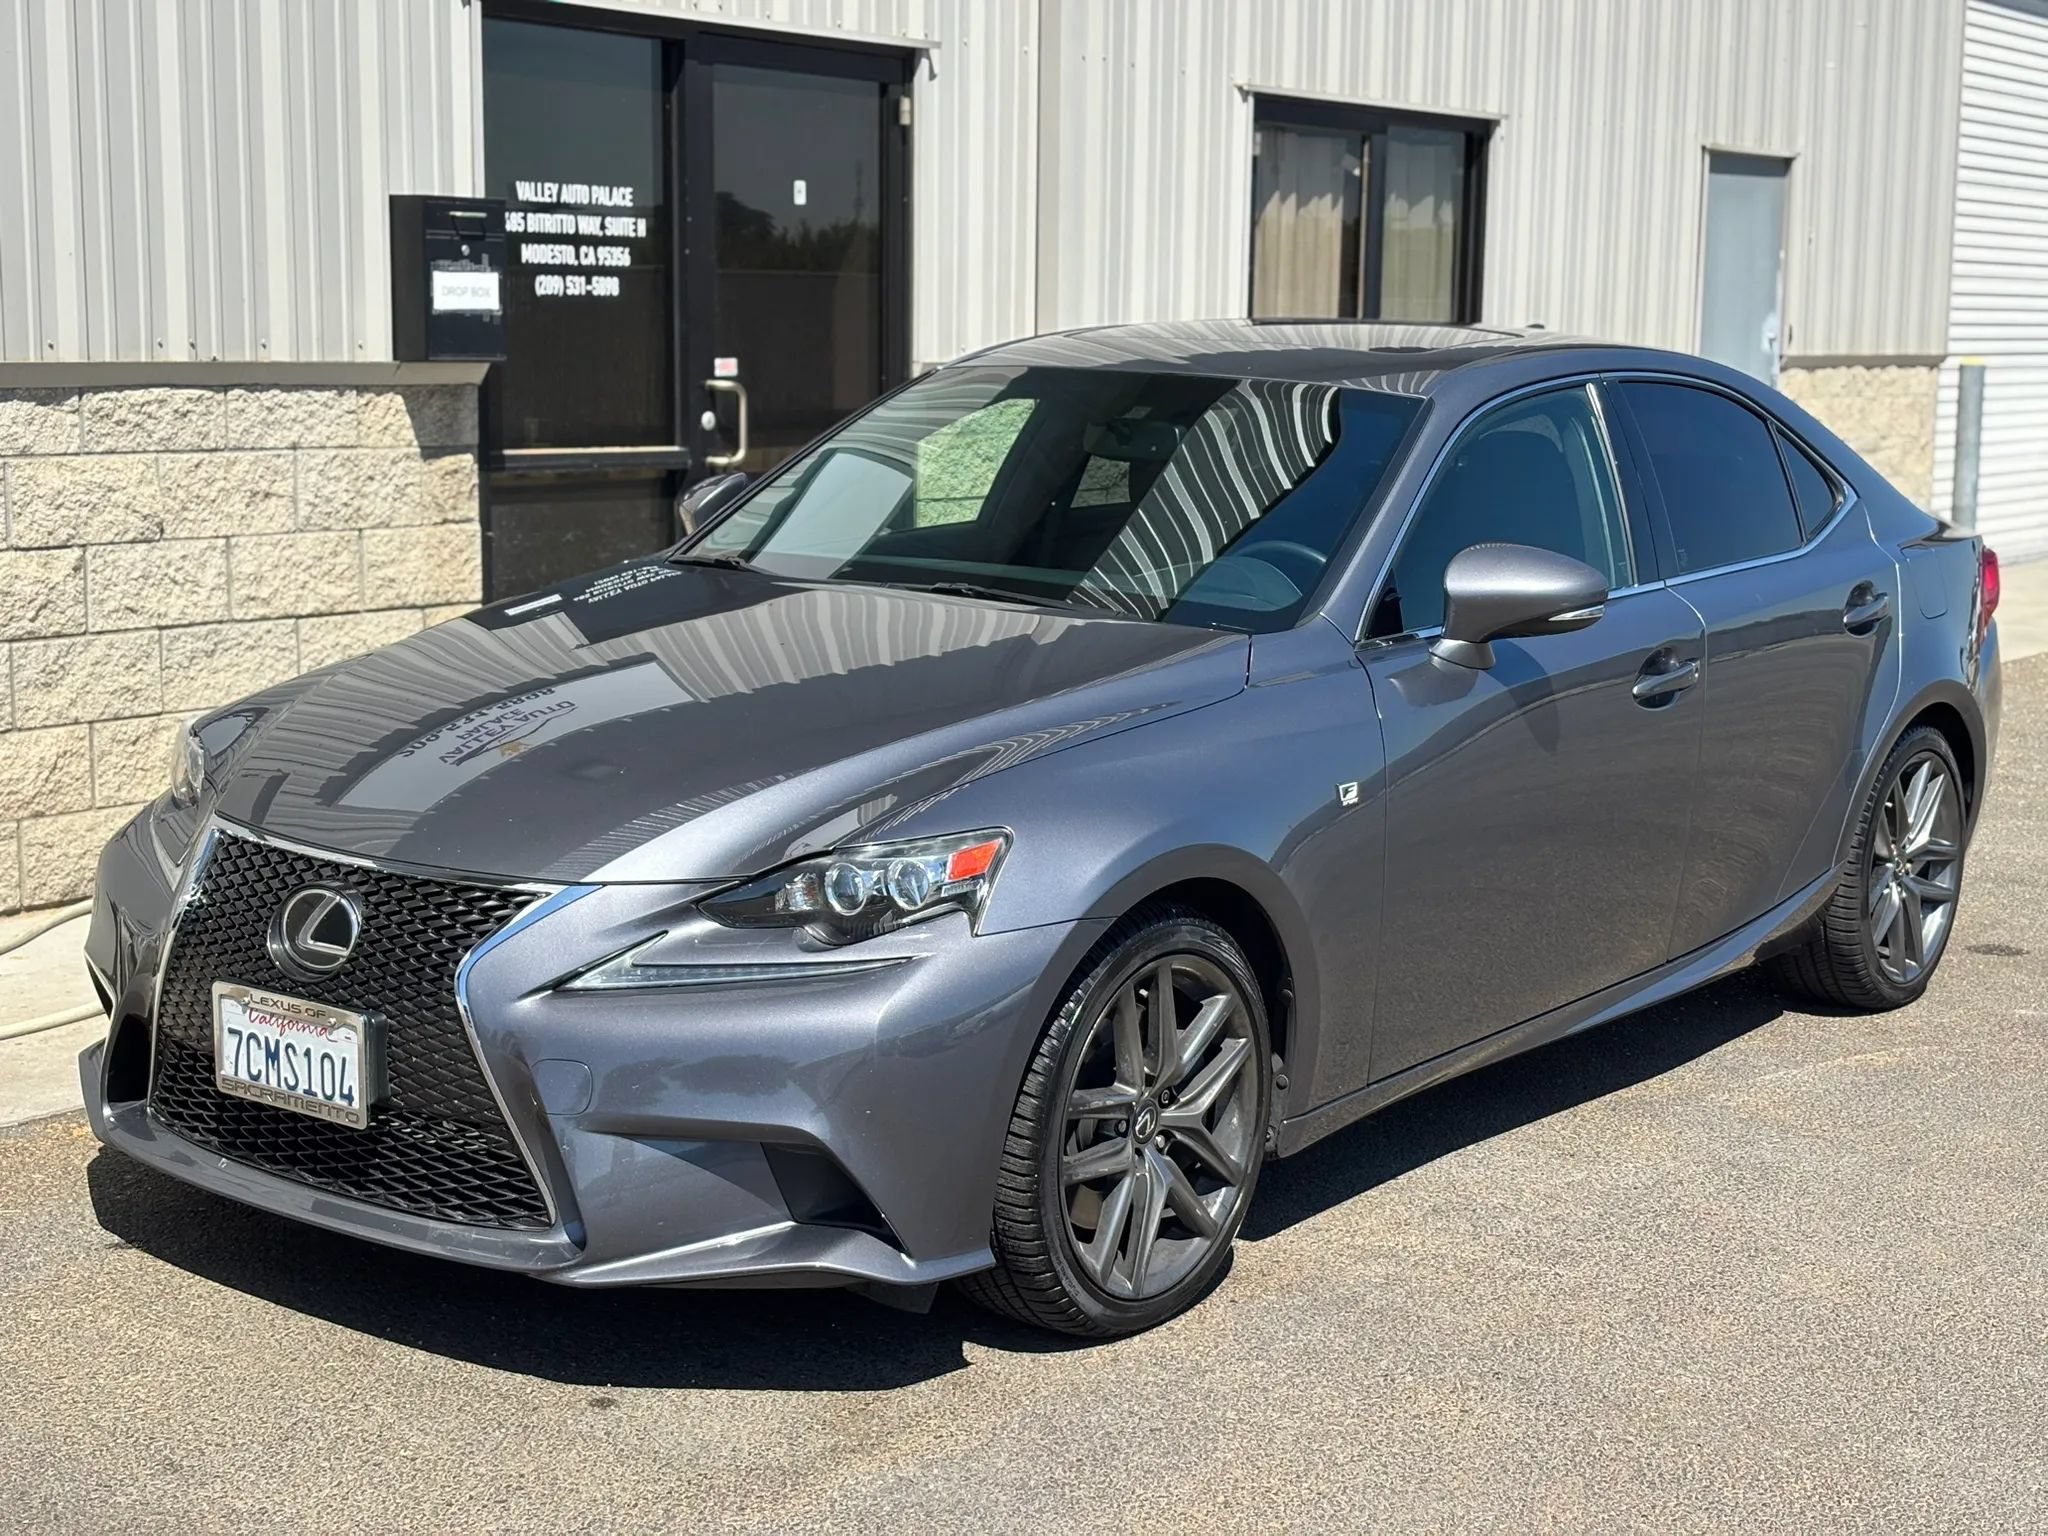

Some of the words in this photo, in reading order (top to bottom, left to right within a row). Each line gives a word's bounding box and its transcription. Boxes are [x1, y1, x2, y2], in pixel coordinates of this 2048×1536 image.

[515, 181, 559, 203] VALLEY
[560, 183, 590, 205] AUTO
[591, 185, 634, 207] PALACE
[526, 212, 576, 234] BITRITTO
[577, 215, 603, 237] WAY,
[604, 216, 636, 237] SUITE
[580, 245, 597, 266] CA
[597, 246, 631, 267] 95356
[441, 286, 469, 297] DROP
[471, 287, 491, 298] BOX
[535, 274, 564, 297] (209)
[250, 993, 302, 1014] LEXUS
[305, 1007, 327, 1019] OF
[248, 1007, 338, 1043] California
[227, 1026, 355, 1107] 7CMS104
[220, 1077, 361, 1124] SACRAMENTO
